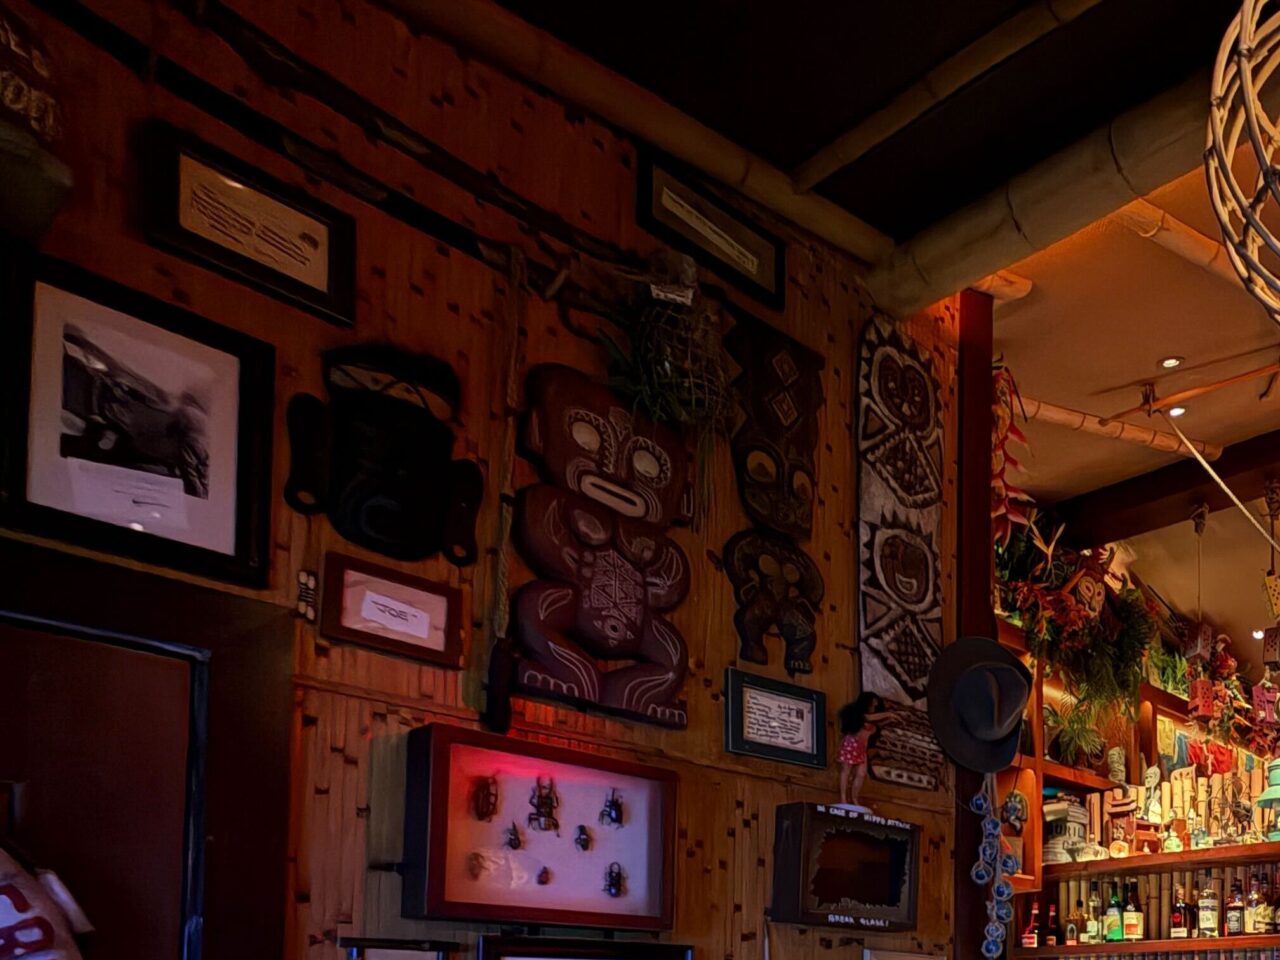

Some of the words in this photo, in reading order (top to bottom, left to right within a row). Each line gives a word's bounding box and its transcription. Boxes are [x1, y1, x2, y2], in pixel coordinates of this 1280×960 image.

[848, 810, 859, 819] OF
[864, 814, 886, 826] HIPPO
[828, 914, 855, 924] BREAK
